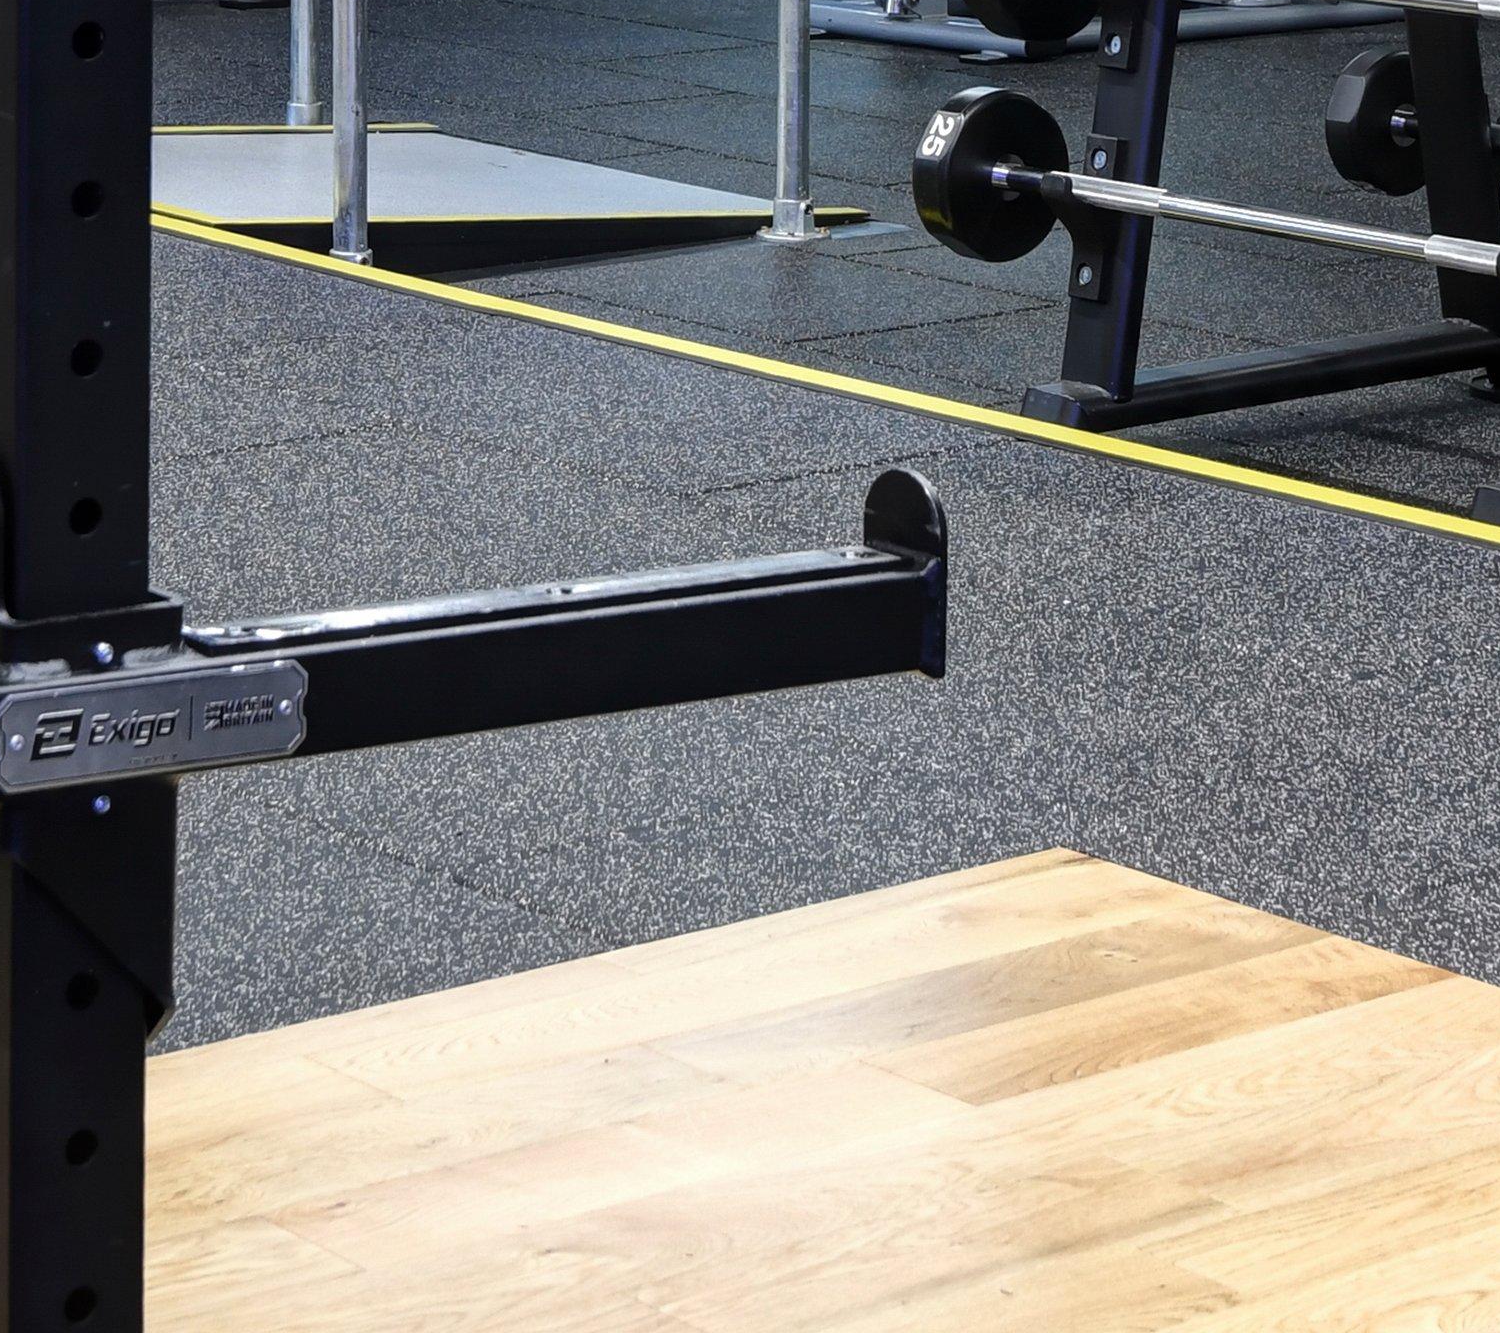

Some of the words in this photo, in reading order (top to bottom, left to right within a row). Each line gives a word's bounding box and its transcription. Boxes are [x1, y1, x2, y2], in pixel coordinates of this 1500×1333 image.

[921, 116, 955, 159] 25
[88, 709, 181, 748] Exigo
[223, 709, 274, 728] BRITAIN
